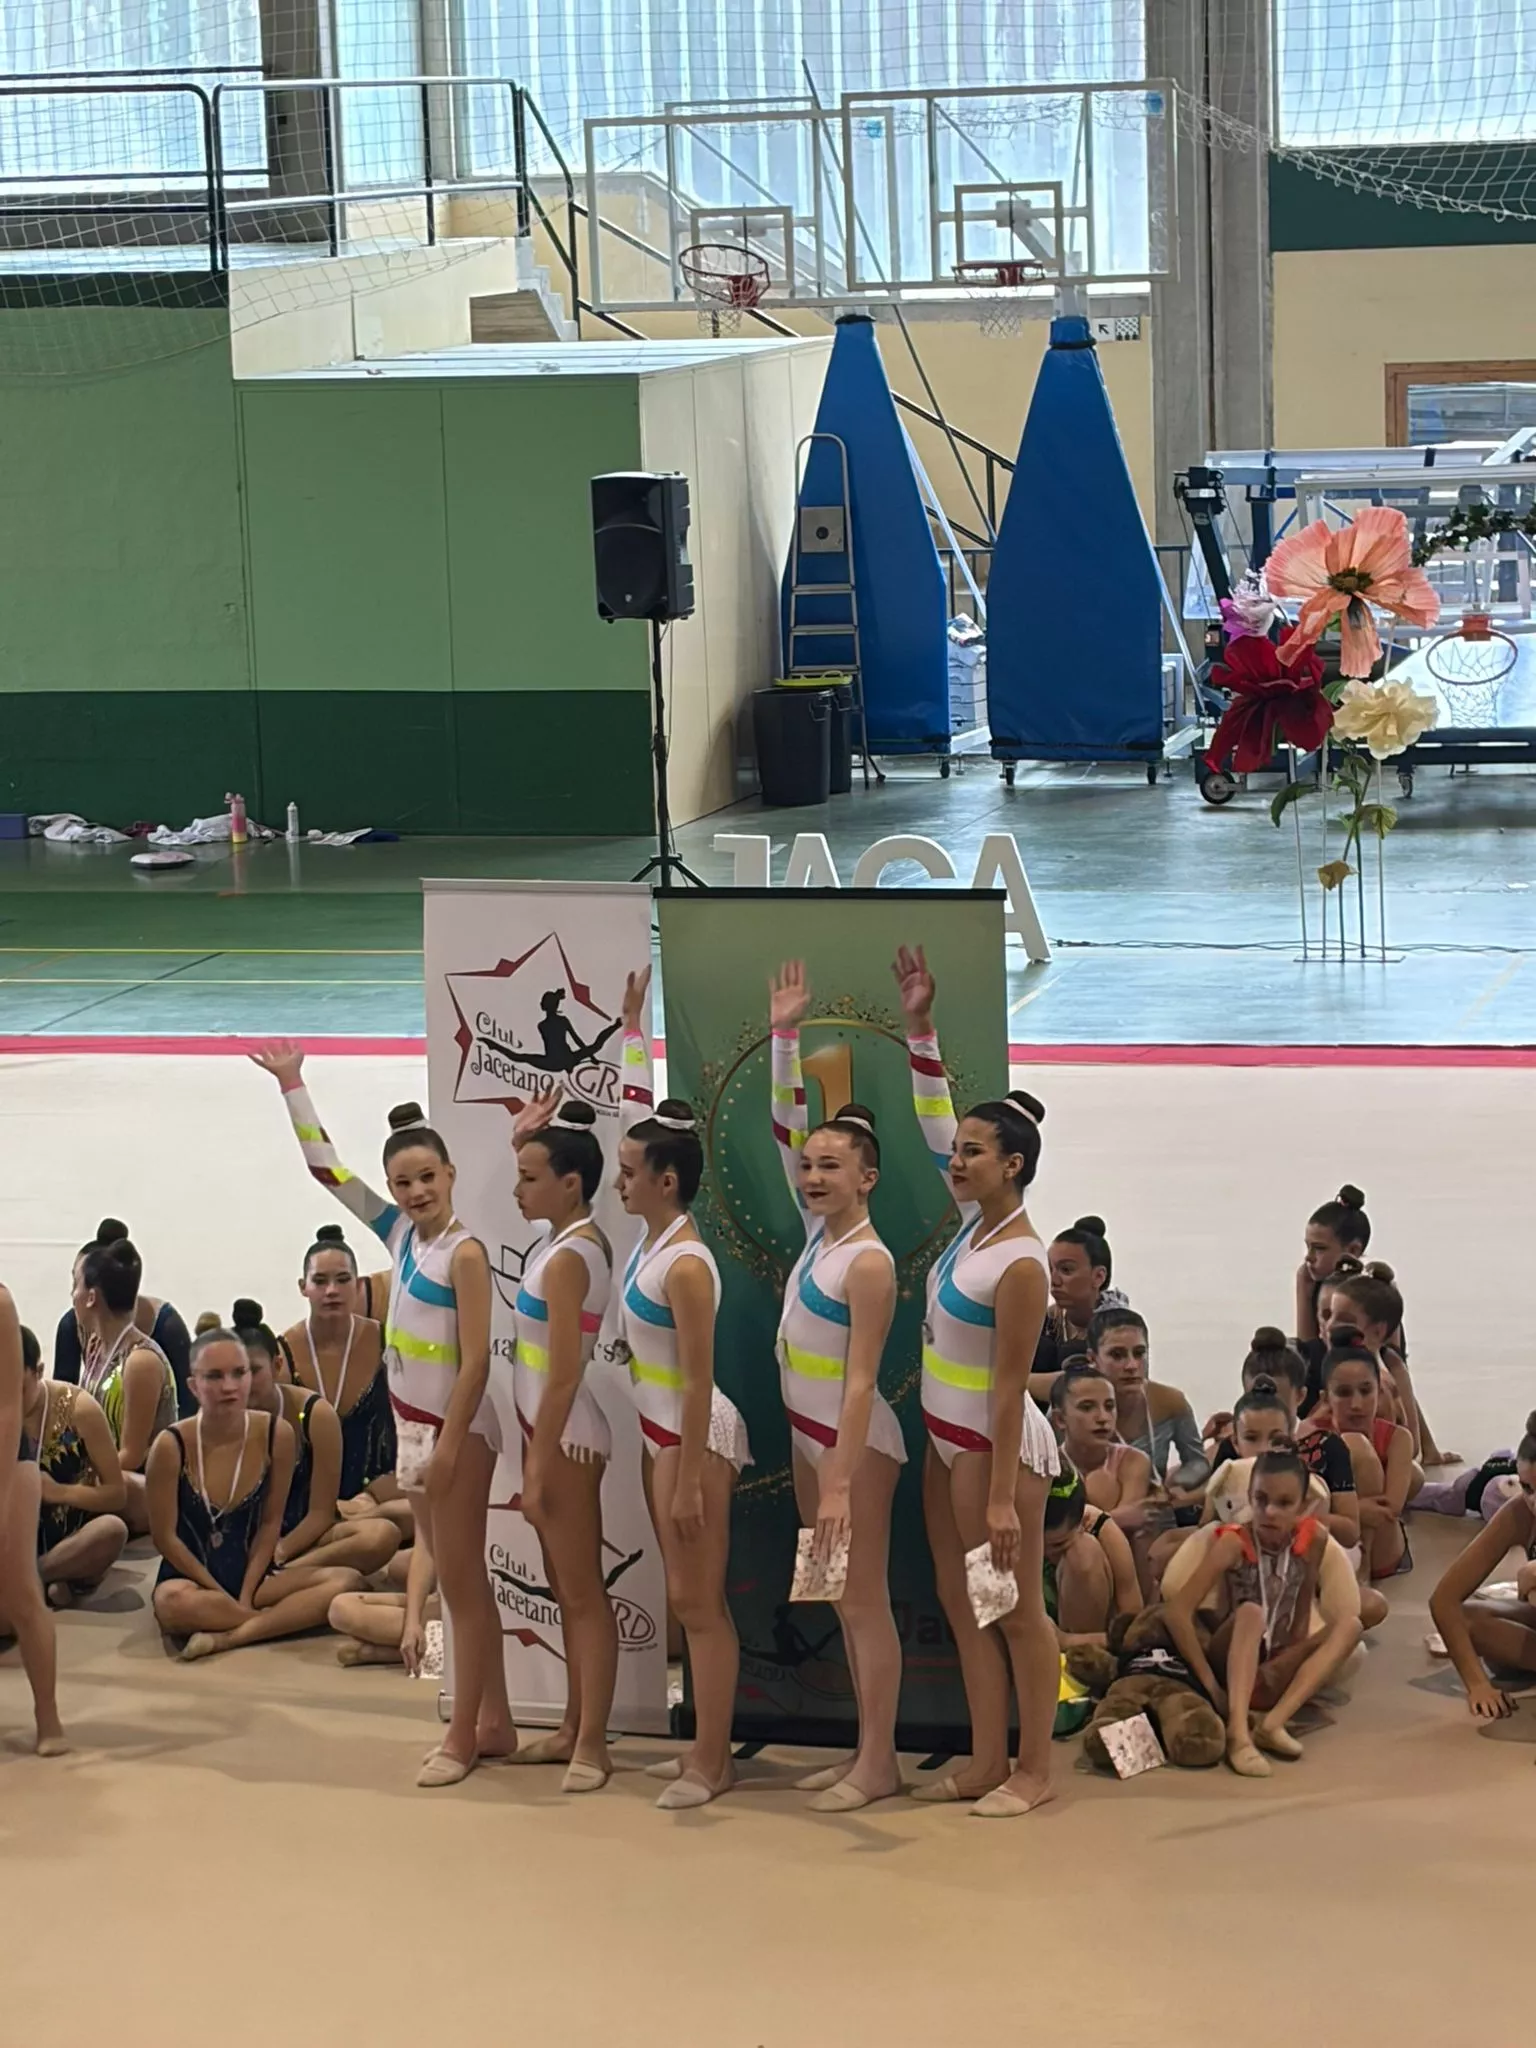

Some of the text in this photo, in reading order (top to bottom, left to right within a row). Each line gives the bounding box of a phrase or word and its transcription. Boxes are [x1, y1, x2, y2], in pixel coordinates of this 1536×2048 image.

[470, 1045, 621, 1104] Jacetano GR
[614, 1602, 652, 1640] RD
